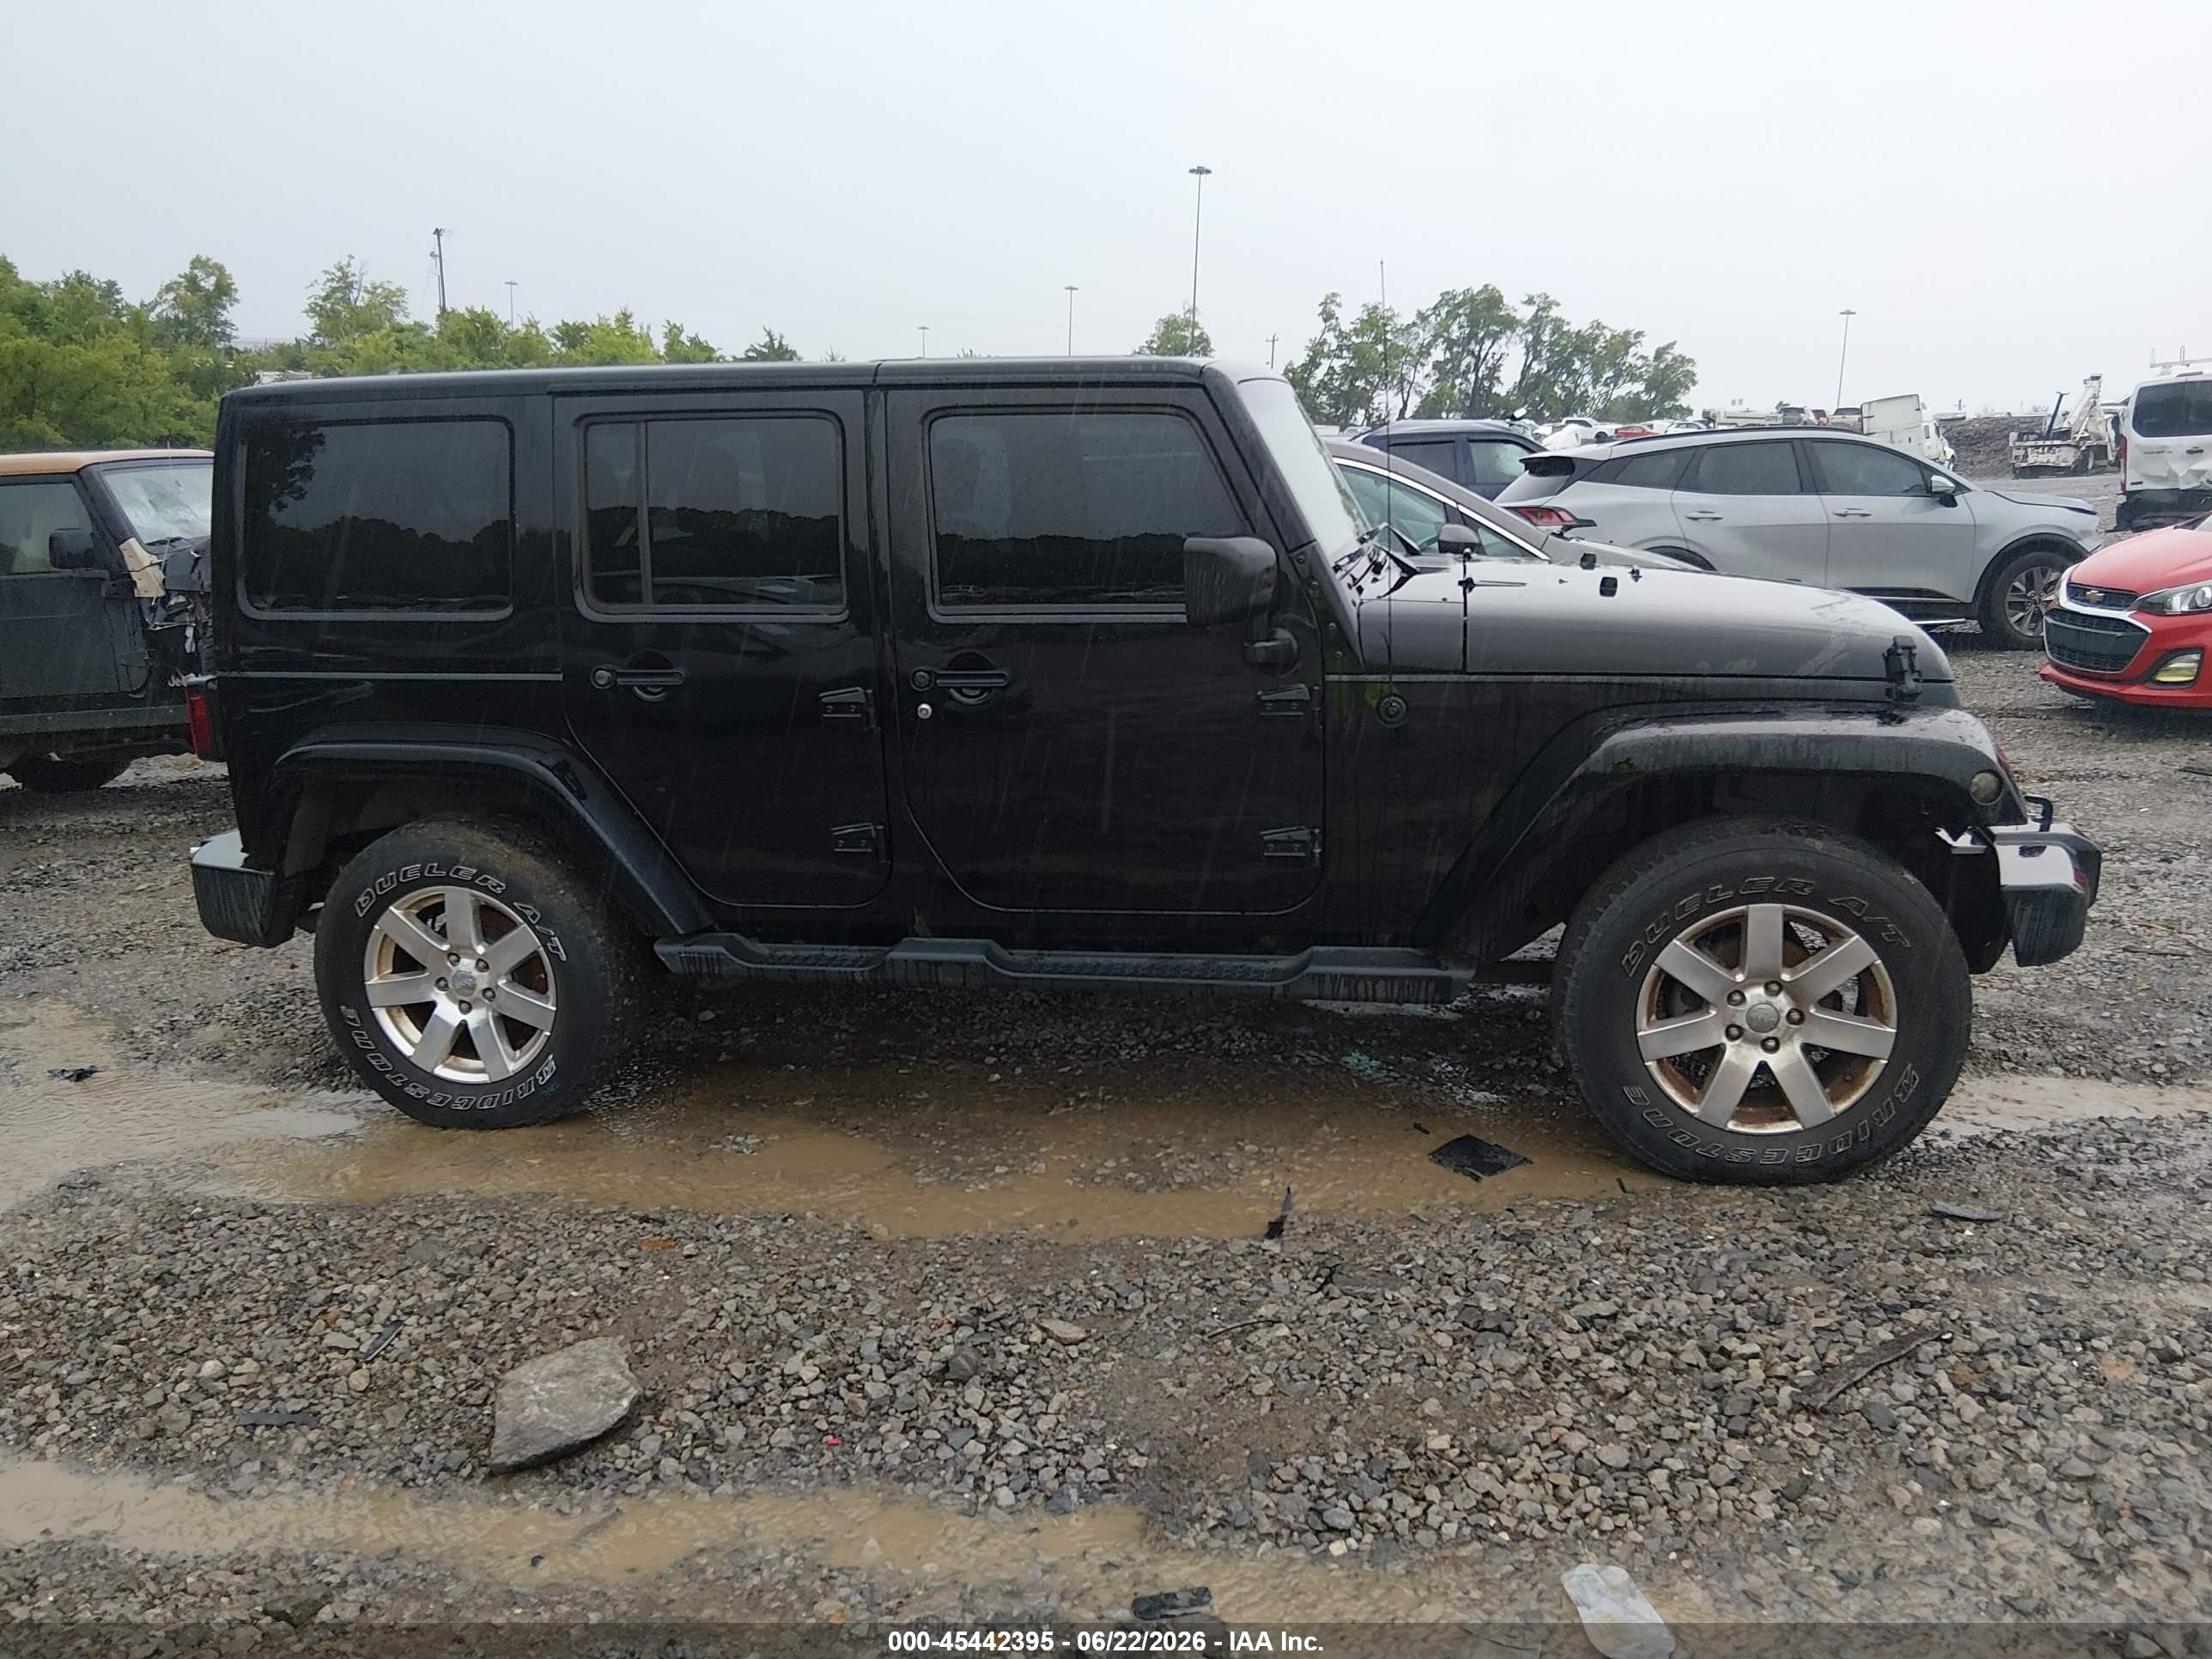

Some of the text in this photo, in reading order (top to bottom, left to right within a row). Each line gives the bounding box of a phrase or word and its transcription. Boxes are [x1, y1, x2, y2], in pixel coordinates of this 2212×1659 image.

[354, 863, 568, 962] DUELER A/T
[1621, 877, 1911, 977] DUELER A/T
[340, 1005, 557, 1110] BRIDGESTONE
[1622, 1064, 1920, 1165] BRIDGESTONE
